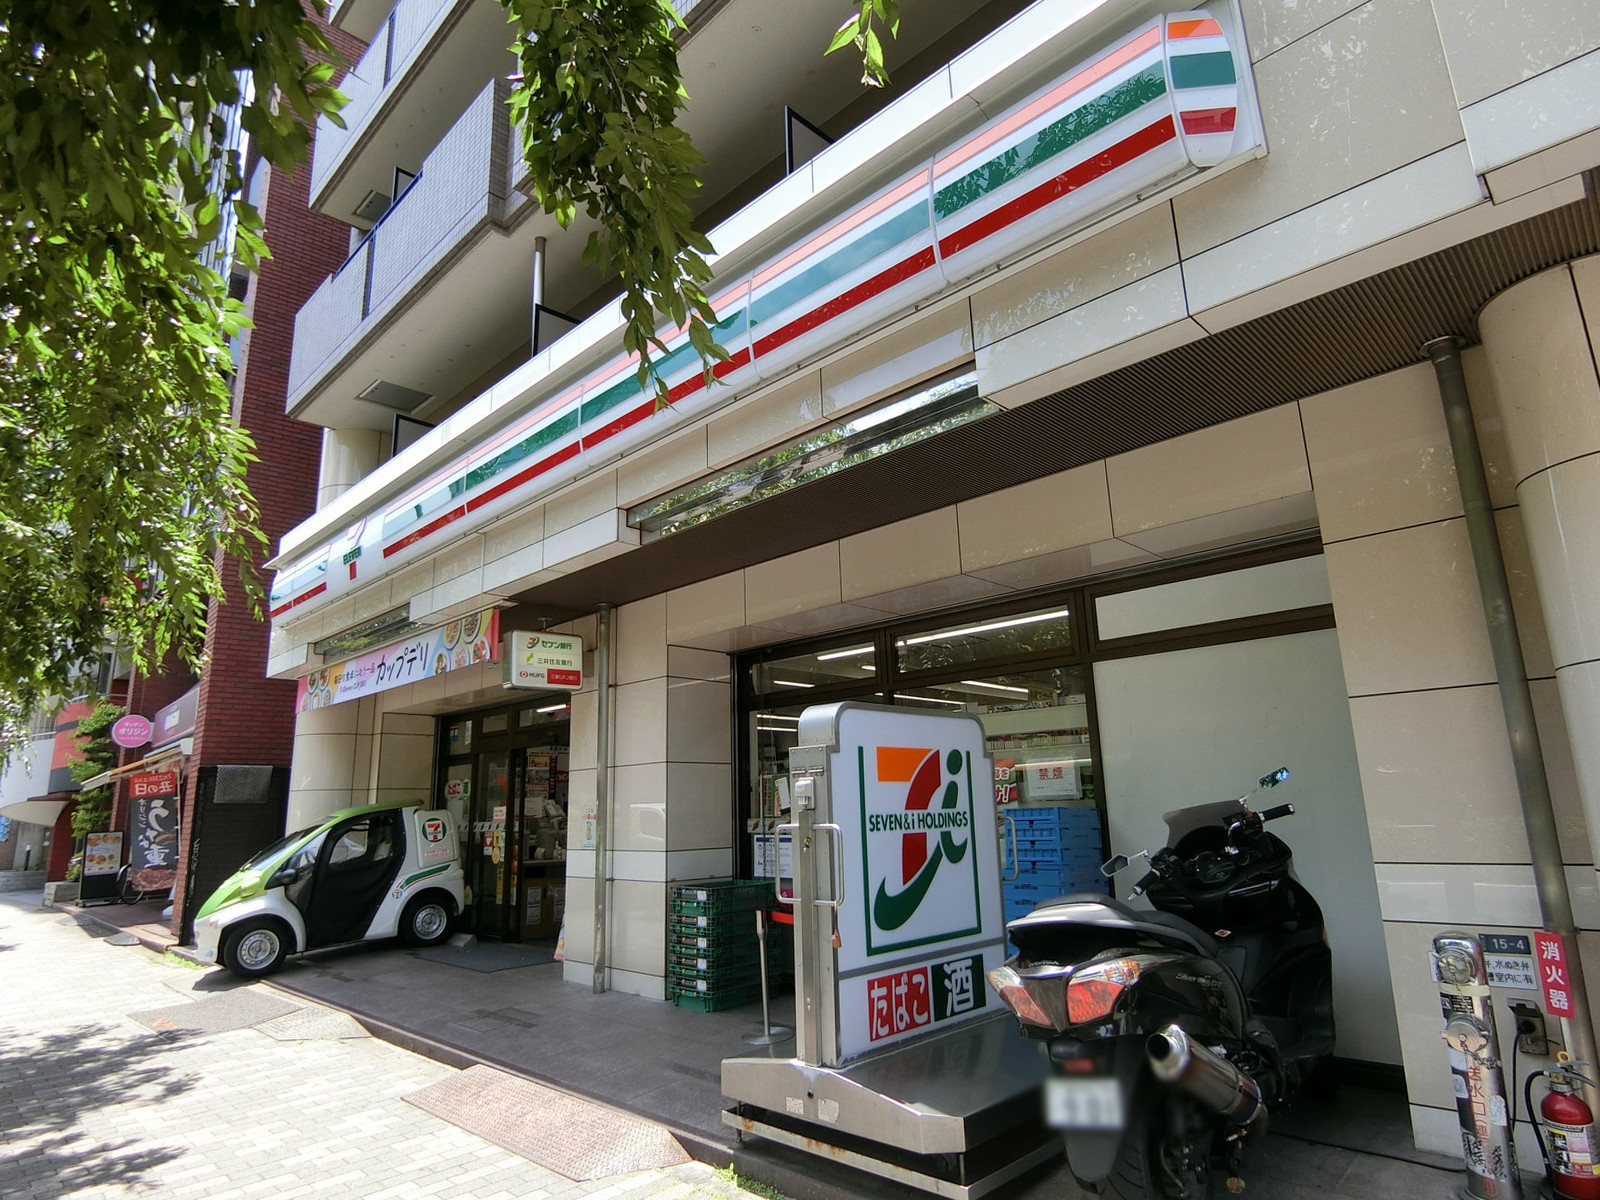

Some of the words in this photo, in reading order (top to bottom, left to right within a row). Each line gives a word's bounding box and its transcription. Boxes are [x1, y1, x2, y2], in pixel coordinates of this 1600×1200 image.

[343, 546, 362, 565] ELEVEN
[541, 640, 572, 650] セブン銀行
[376, 642, 429, 685] カップデリ
[537, 658, 573, 667] 三井住友銀行
[1038, 767, 1064, 780] 禁煙
[868, 812, 915, 832] SEVEN&i
[917, 811, 968, 829] HOLDINGS
[1492, 938, 1525, 950] 15-4
[1540, 941, 1569, 1010] 消火器
[943, 958, 975, 1017] 酒
[870, 972, 929, 1040] たばこ
